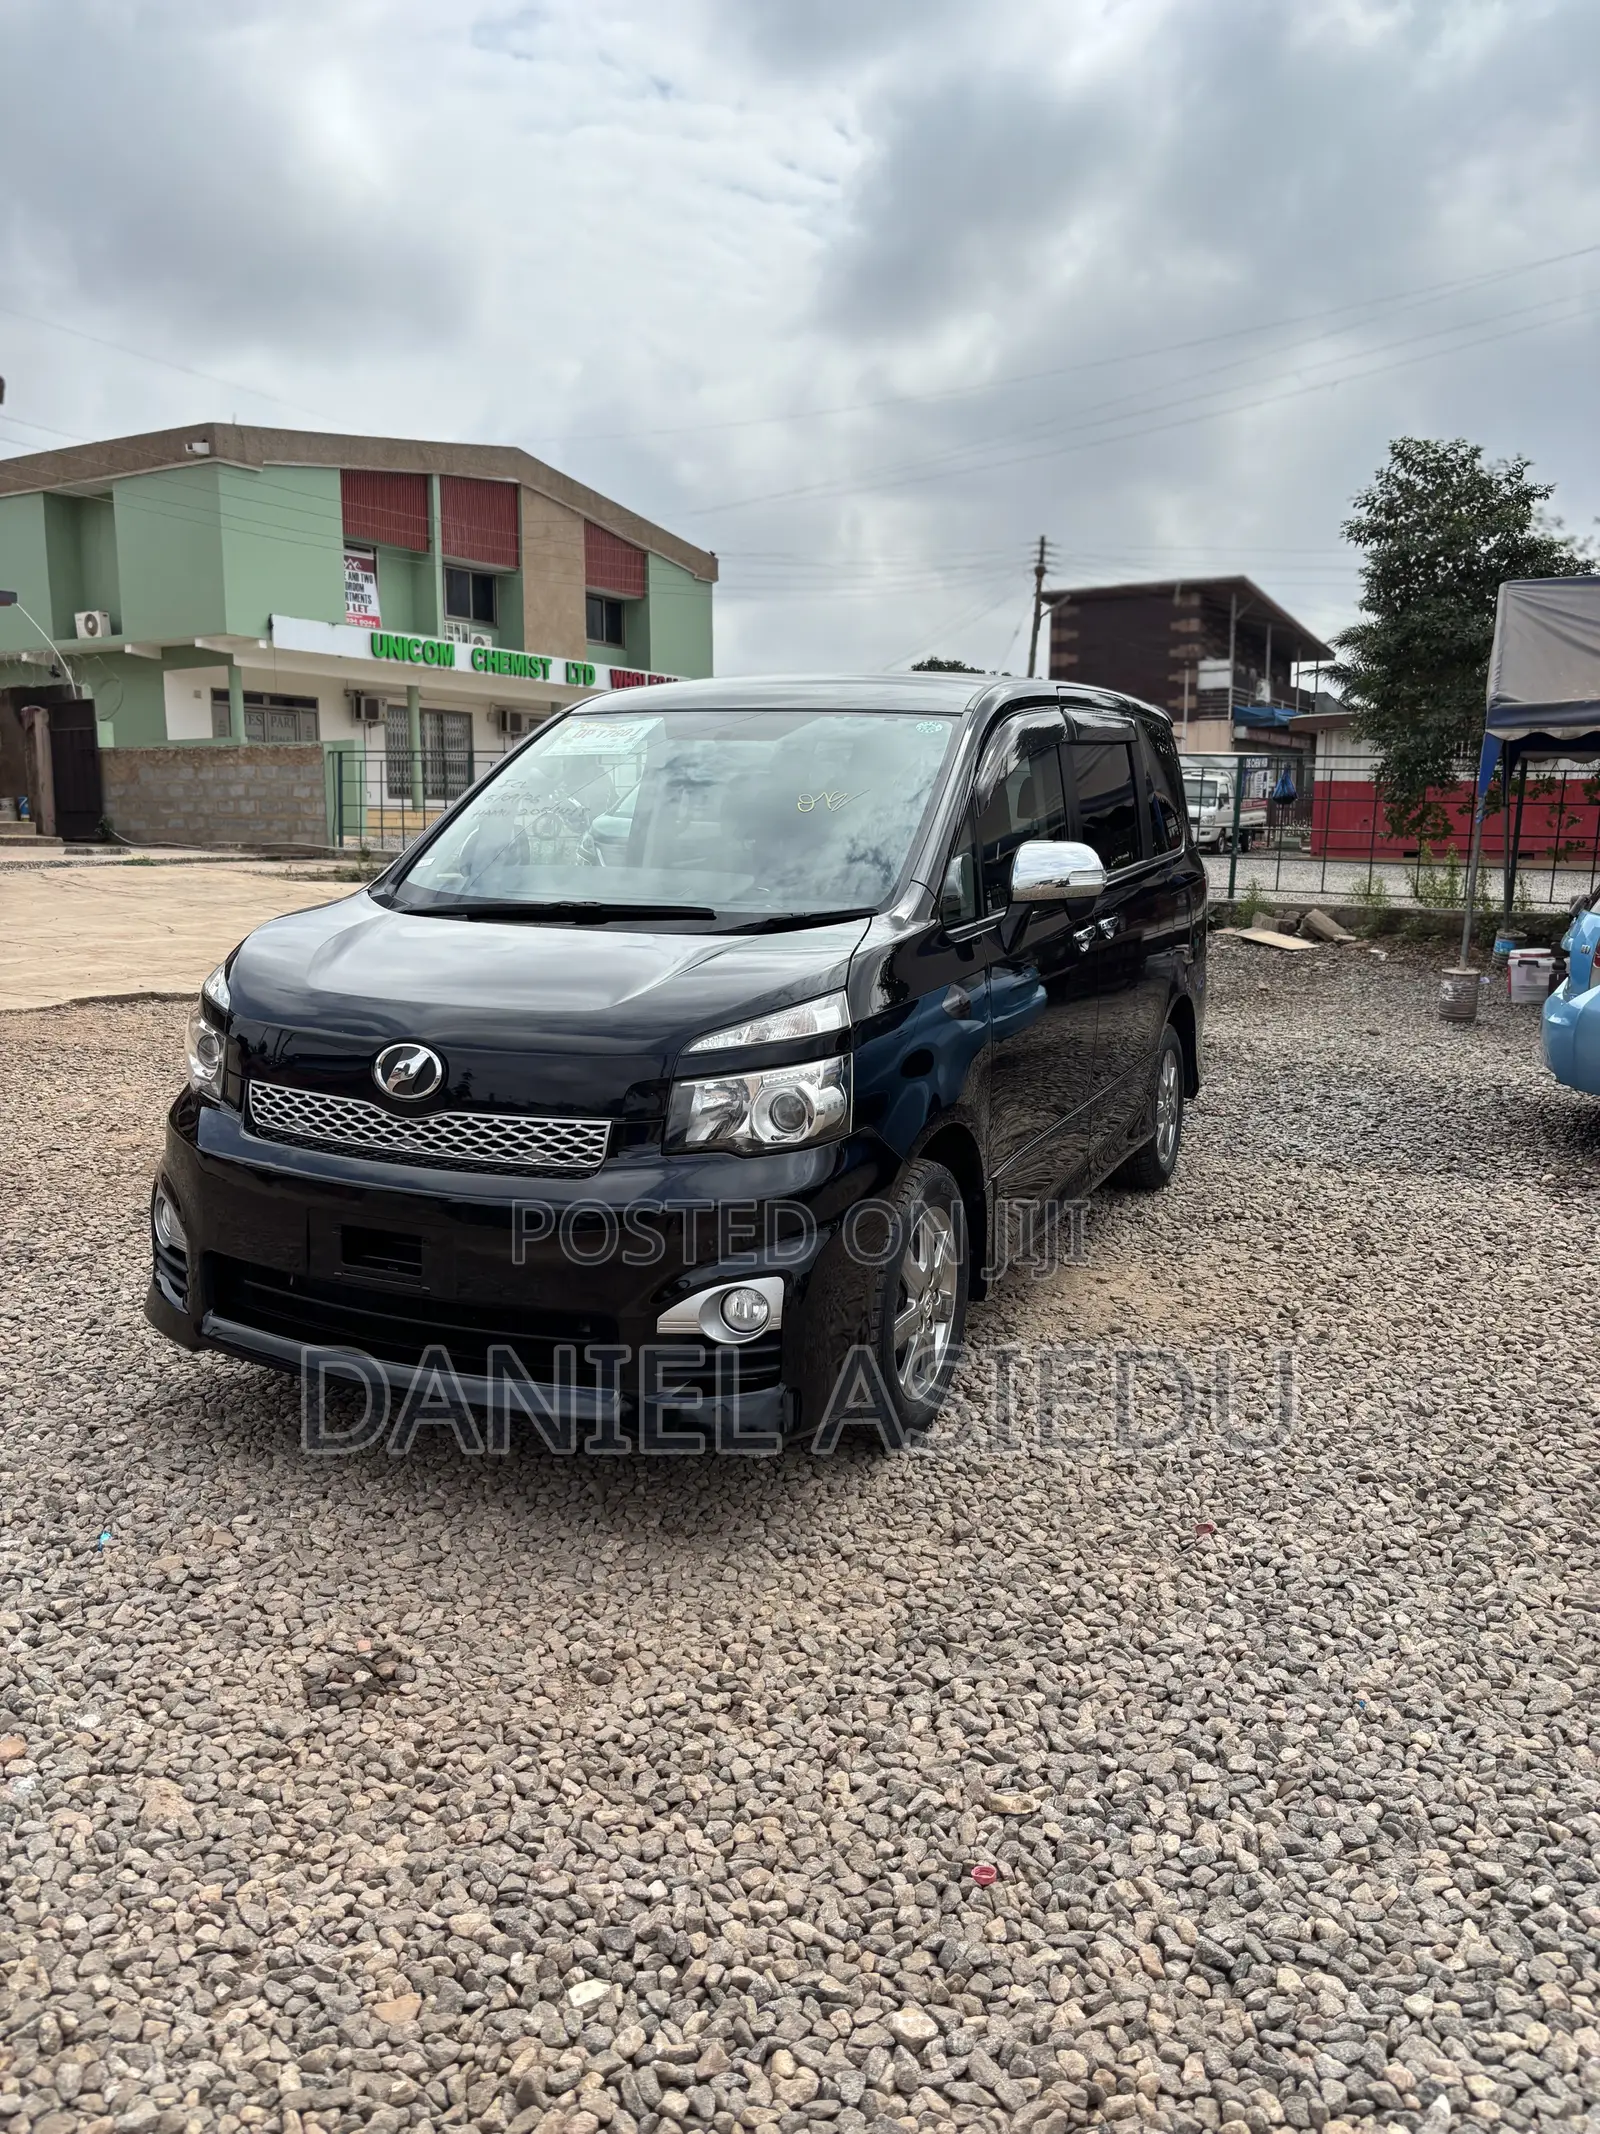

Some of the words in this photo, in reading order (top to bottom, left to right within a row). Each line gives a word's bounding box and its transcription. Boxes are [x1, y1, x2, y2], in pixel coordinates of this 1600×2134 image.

[348, 572, 359, 582] AND
[361, 574, 373, 584] TWO
[353, 604, 368, 613] LET
[371, 633, 455, 666] UNICOM
[472, 647, 552, 681] CHEMIST
[566, 661, 596, 687] LTD
